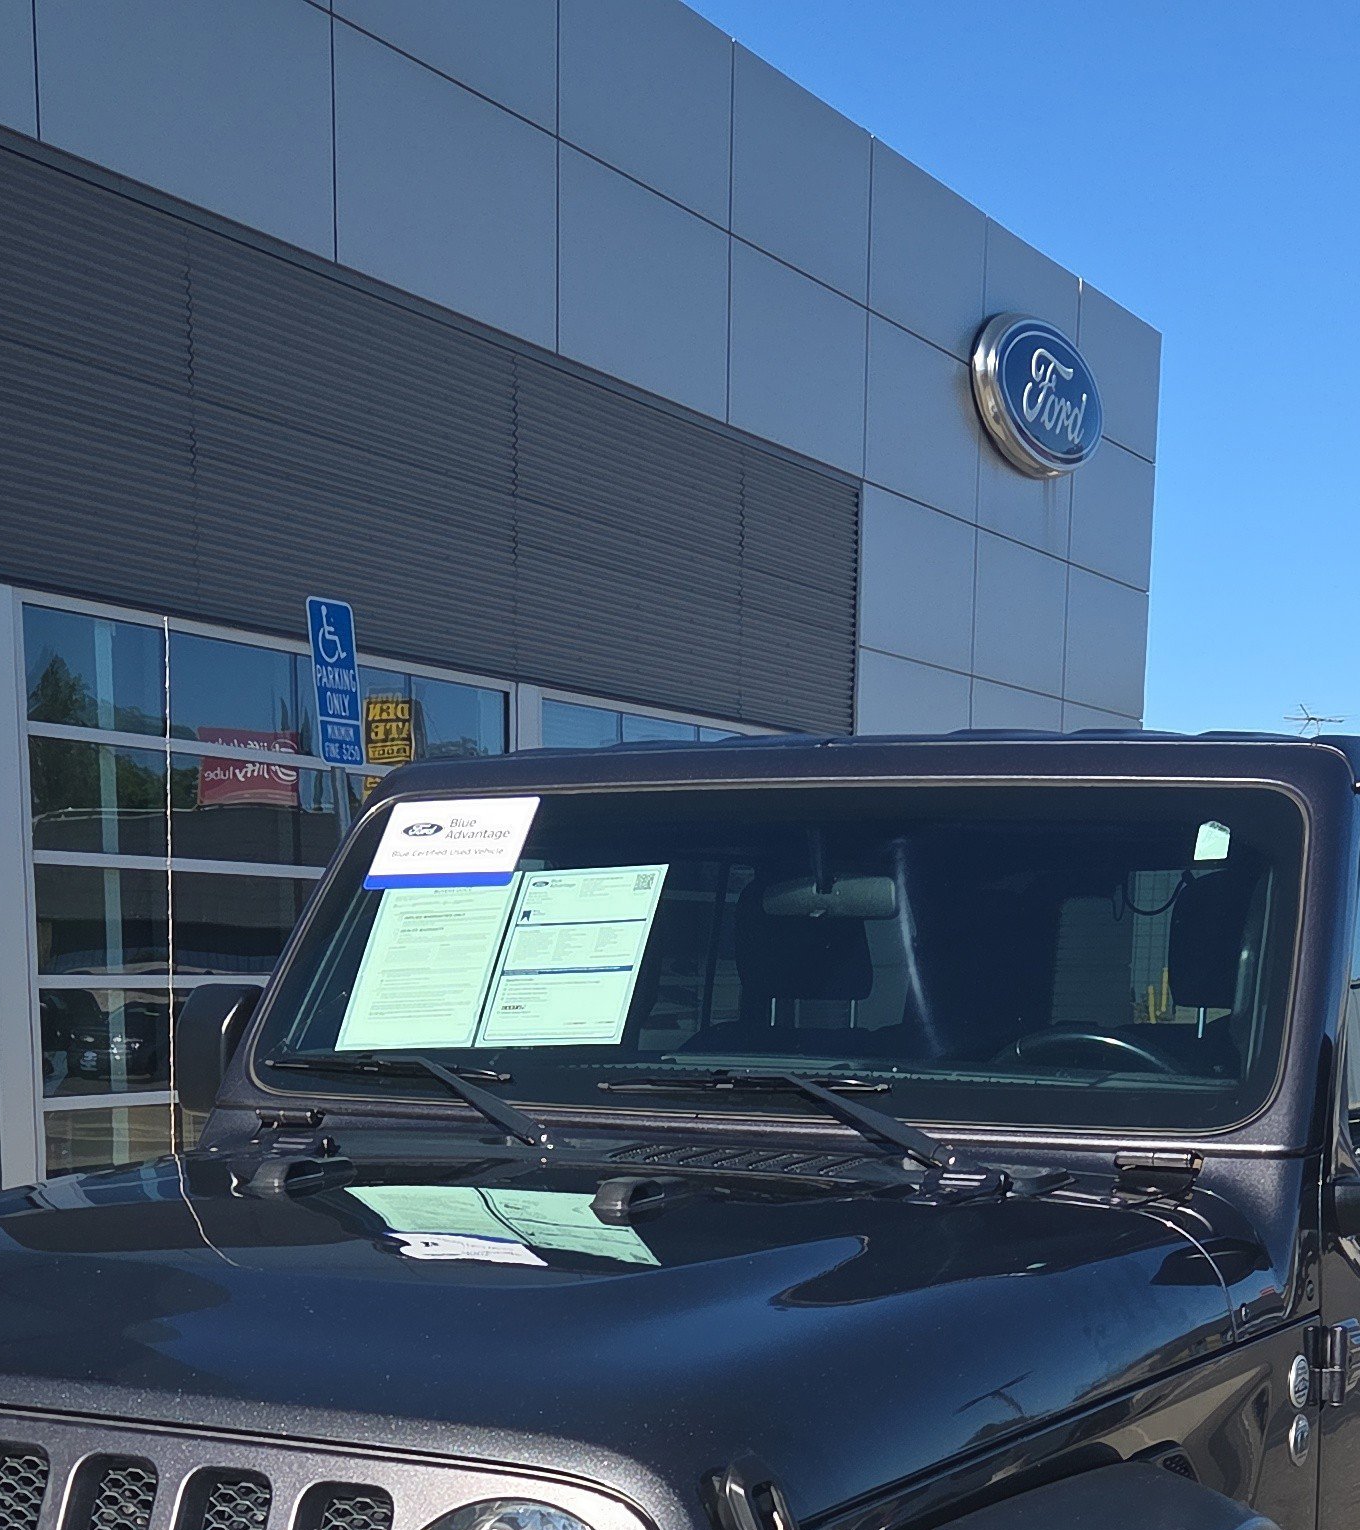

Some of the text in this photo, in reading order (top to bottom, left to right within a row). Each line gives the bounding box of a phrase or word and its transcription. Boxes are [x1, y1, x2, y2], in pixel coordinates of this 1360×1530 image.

[1022, 348, 1088, 445] Ford
[316, 664, 356, 692] PARKING
[326, 691, 350, 716] ONLY
[445, 829, 511, 840] Advantage
[449, 818, 477, 828] Blue
